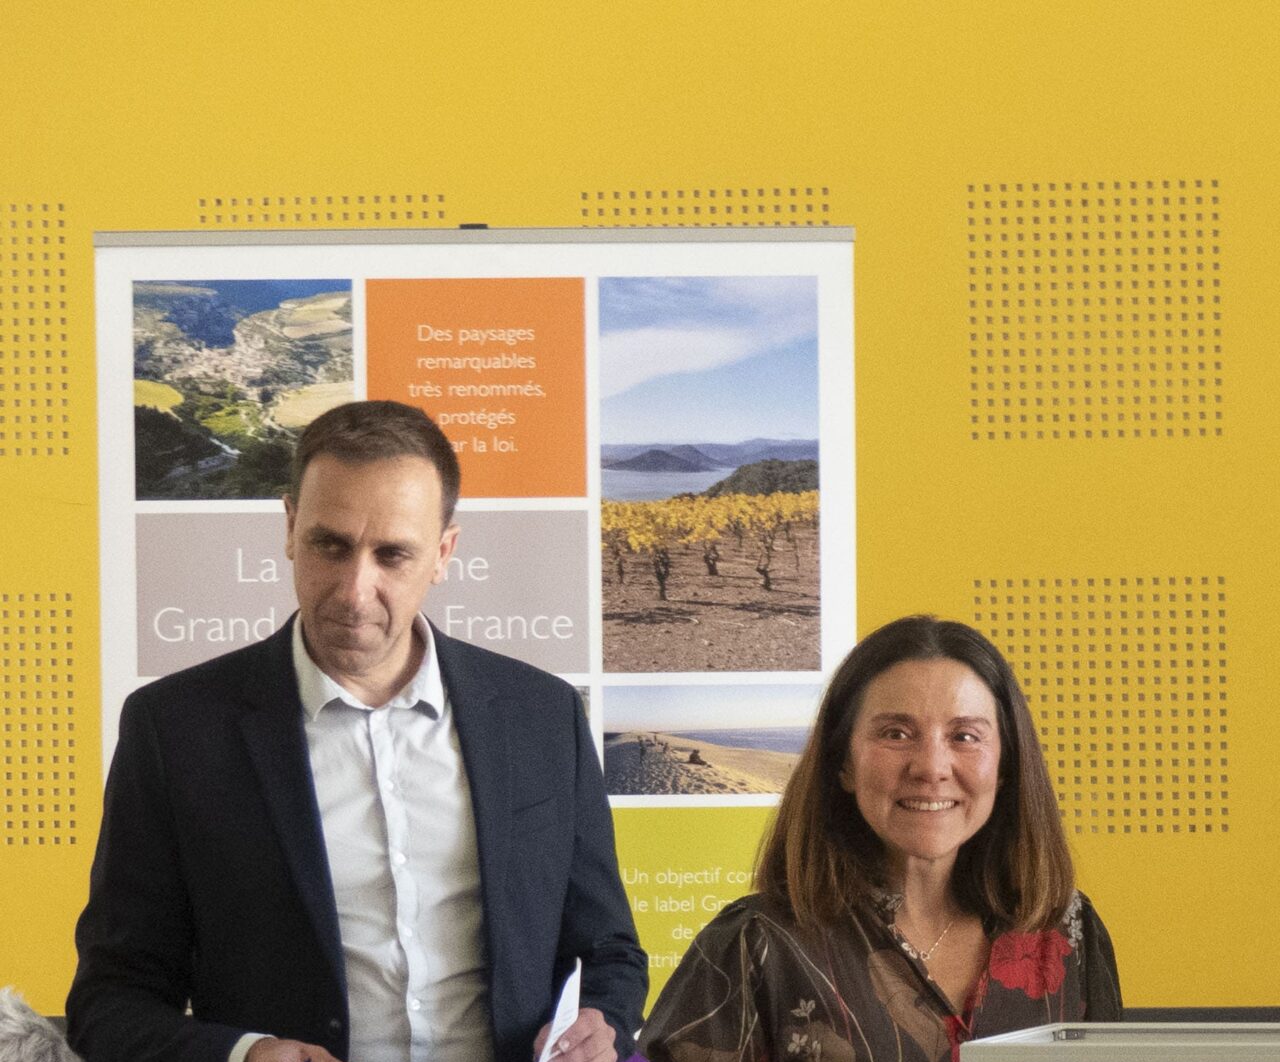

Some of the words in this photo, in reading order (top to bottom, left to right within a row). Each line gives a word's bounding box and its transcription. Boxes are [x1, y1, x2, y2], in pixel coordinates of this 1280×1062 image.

[417, 325, 453, 342] Des
[458, 327, 536, 346] paysages
[417, 353, 537, 374] remarquables
[408, 381, 442, 398] très
[448, 380, 547, 398] renommés,
[438, 408, 517, 430] protégés
[473, 436, 487, 453] la
[493, 436, 519, 453] loi.
[236, 547, 280, 583] La
[153, 606, 276, 643] Grand
[446, 605, 574, 640] France
[622, 868, 649, 884] Un
[655, 867, 722, 889] objectif
[633, 896, 649, 913] le
[655, 896, 695, 913] label
[671, 924, 693, 940] de
